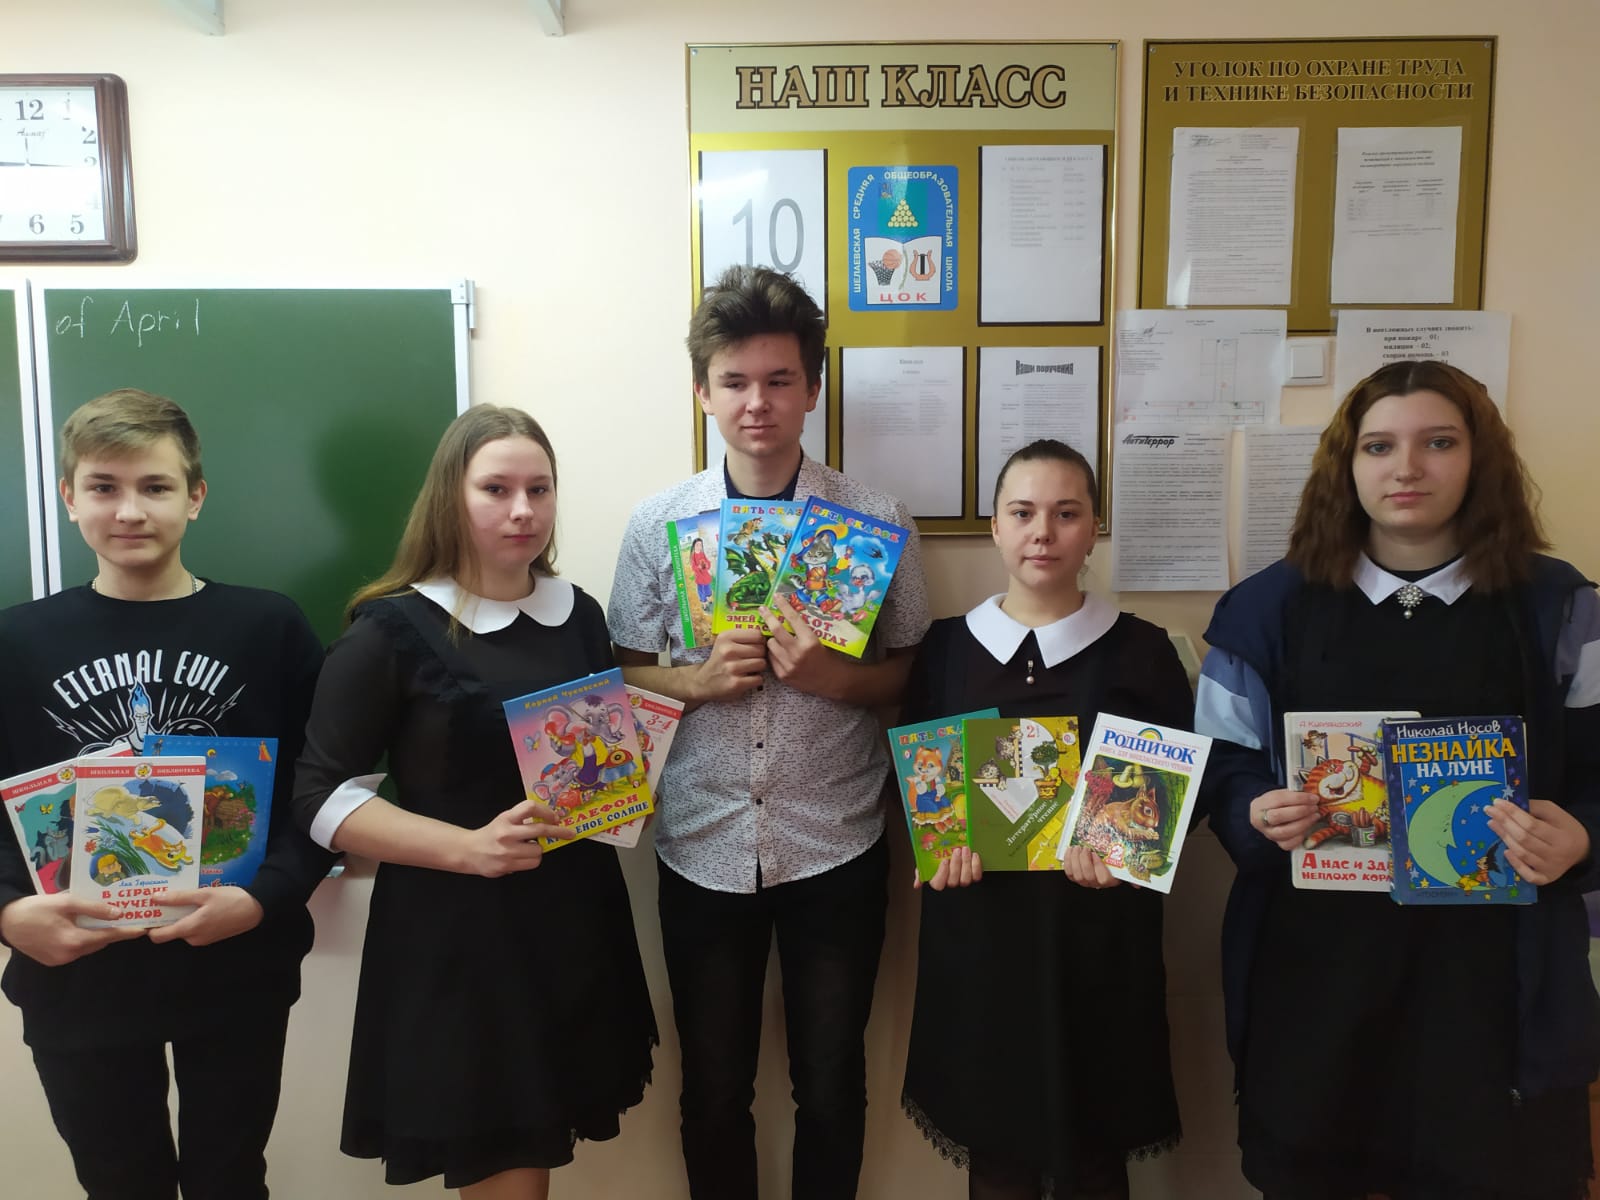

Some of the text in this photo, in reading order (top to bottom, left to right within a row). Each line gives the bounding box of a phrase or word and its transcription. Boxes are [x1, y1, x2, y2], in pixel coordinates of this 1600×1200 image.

[1174, 57, 1466, 79] УГОЛОК ПО ОХРАНЕ ТРУДА
[736, 65, 1067, 108] НАШ КЛАСС
[1164, 82, 1475, 101] И ТЕХНИКЕ БЕЗОПАСНОСТИ
[15, 98, 44, 121] 12
[81, 125, 97, 144] 2
[853, 173, 876, 220] СРЕДНЯЯ
[883, 170, 954, 248] ОБЩЕОБРАЗОВАТЕЛЬНАЯ
[29, 214, 45, 235] 6
[70, 214, 84, 235] 5
[732, 198, 804, 272] 10
[853, 228, 861, 293] ШЕЛАЕВСКАЯ
[945, 256, 953, 292] ШКОЛА
[56, 295, 200, 348] of April
[732, 505, 803, 516] ПЯТЬ СКАЗ
[812, 504, 900, 543] ПЯТЬ СКАЗОК
[726, 614, 755, 623] ЗМЕЙ
[52, 649, 163, 710] ETERNAL
[524, 678, 611, 710] Корней Чуковский
[899, 730, 935, 746] ПЯТЬ
[1026, 725, 1036, 738] 2
[1396, 720, 1501, 739] Николай Носов
[1102, 729, 1197, 765] РОДНИЧОК
[1392, 733, 1517, 763] НЕЗНАЙКА
[1416, 760, 1495, 778] НА ЛУНЕ
[560, 794, 639, 828] ЕЛЕФОН
[606, 801, 649, 823] СОЛНЦЕ
[1302, 852, 1317, 869] А
[1321, 859, 1350, 869] НАС
[1302, 871, 1357, 881] НЕПЛОХО
[102, 890, 112, 899] В
